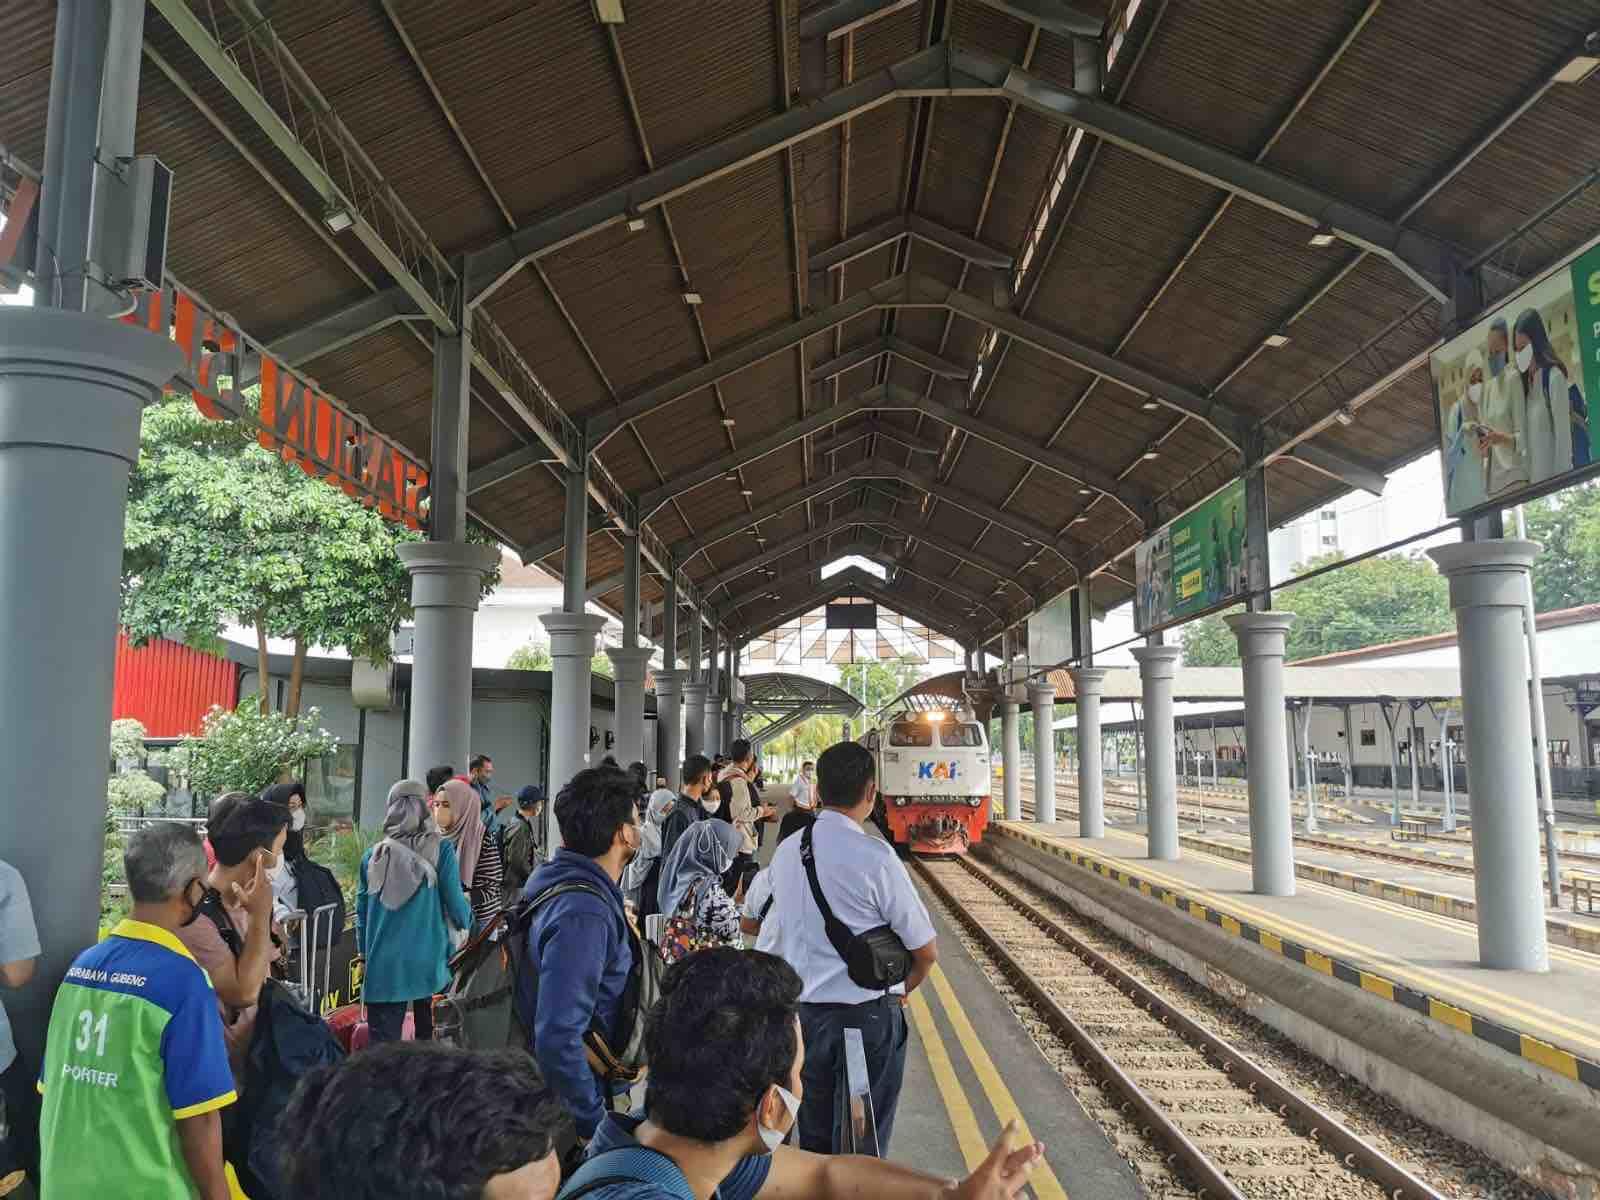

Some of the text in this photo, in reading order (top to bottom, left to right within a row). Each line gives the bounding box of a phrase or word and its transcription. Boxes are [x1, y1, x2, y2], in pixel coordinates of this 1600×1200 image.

[110, 972, 147, 987] GUBENG
[76, 1009, 109, 1057] 31
[62, 1063, 119, 1088] PORTER
